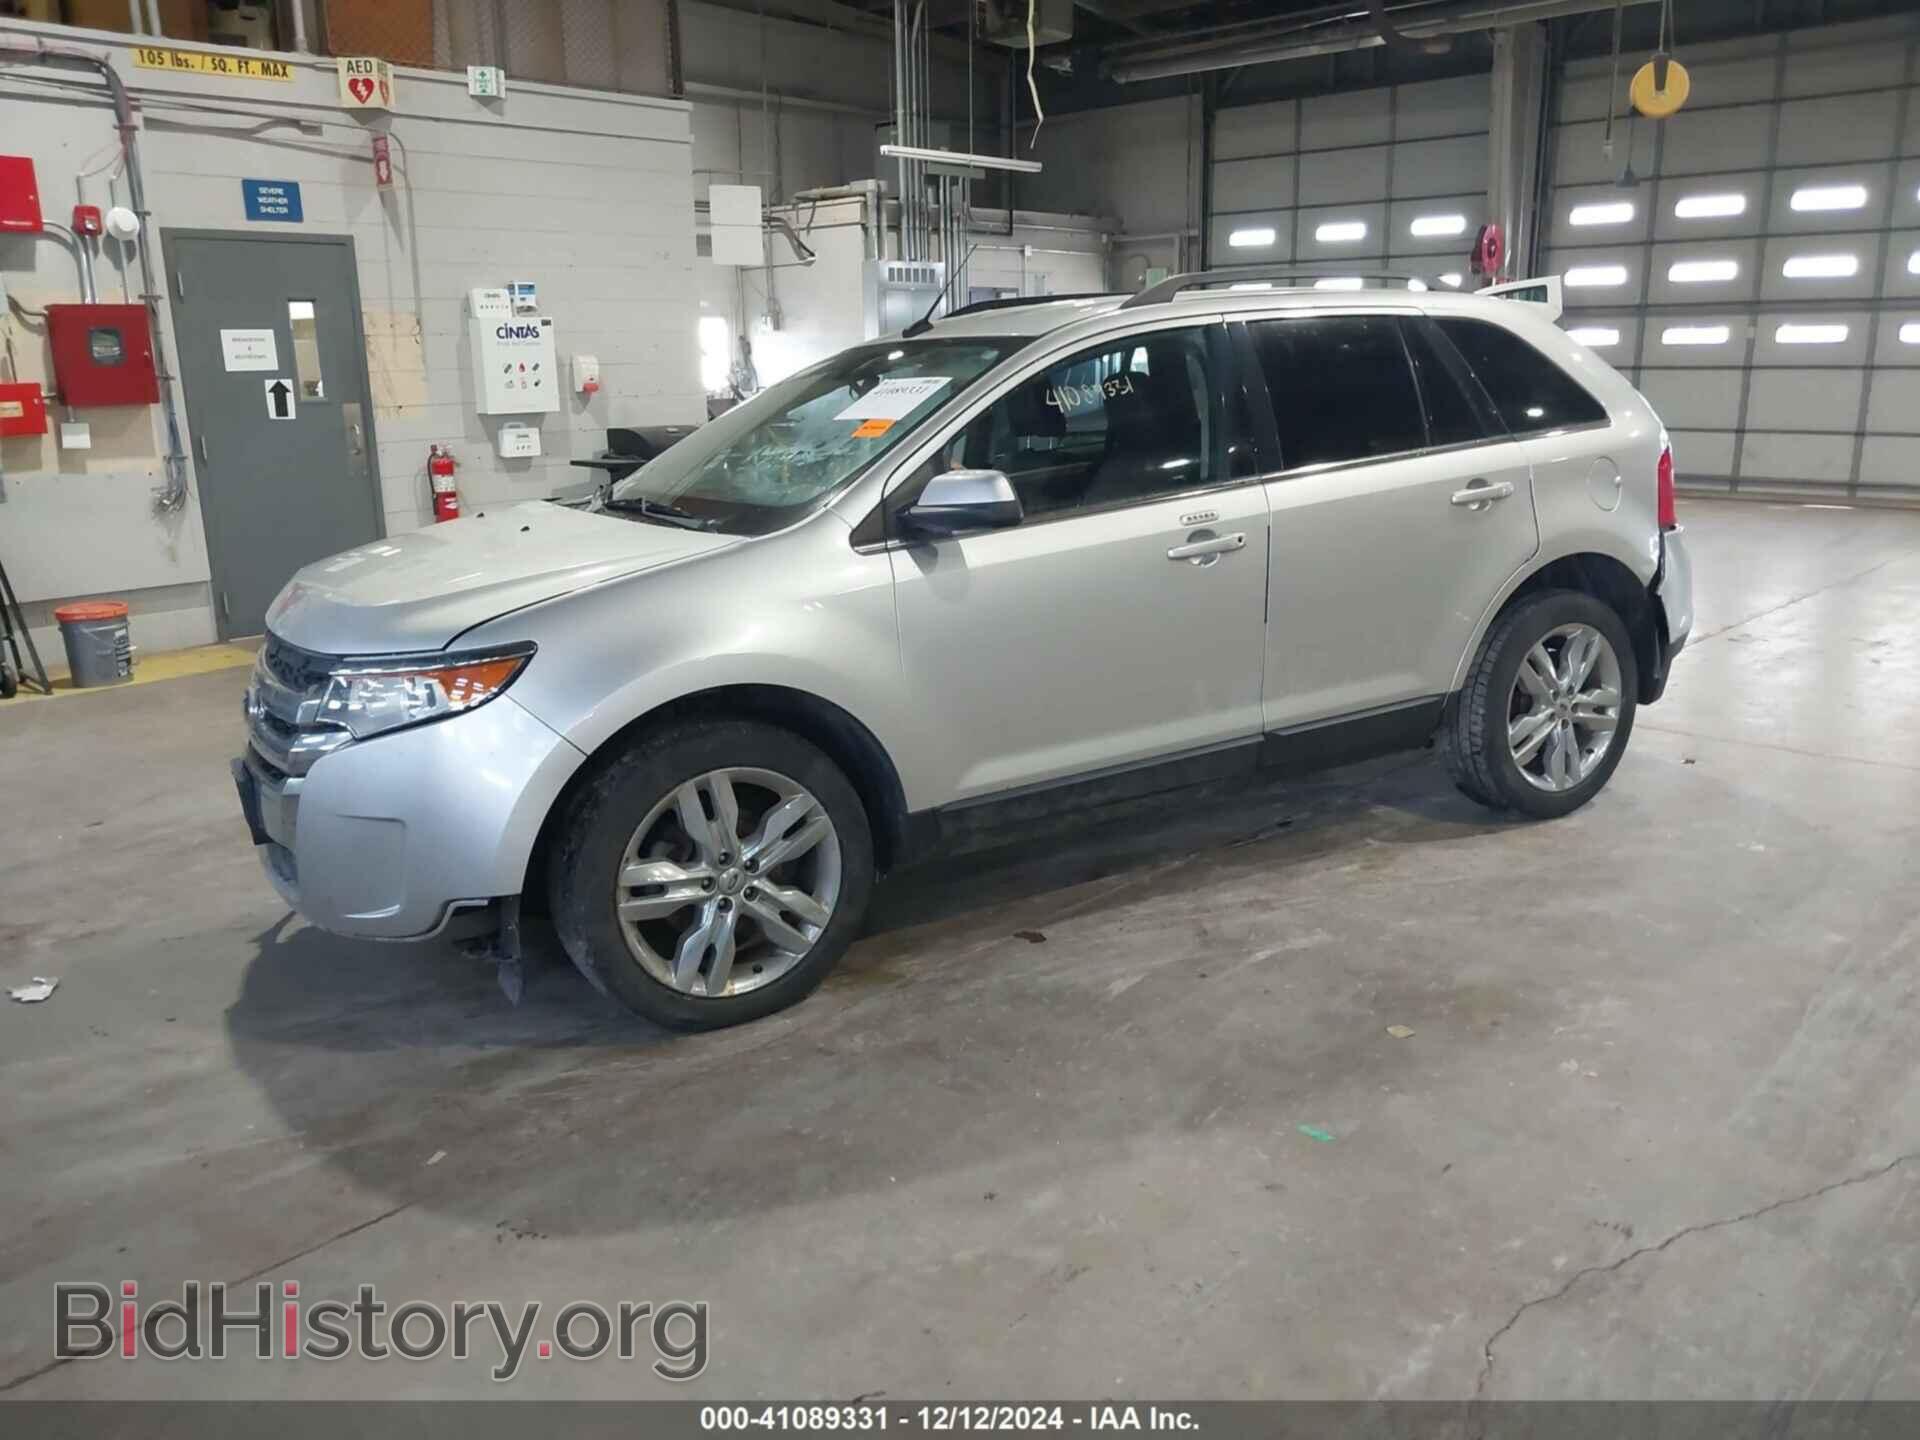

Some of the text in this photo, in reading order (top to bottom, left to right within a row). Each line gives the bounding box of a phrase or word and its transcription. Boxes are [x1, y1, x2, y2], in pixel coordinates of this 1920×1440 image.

[138, 50, 289, 78] 105 lbs. / SQ. FT. MAX
[347, 59, 373, 73] AED
[258, 186, 285, 195] SEVERE
[260, 205, 289, 214] SHELTER
